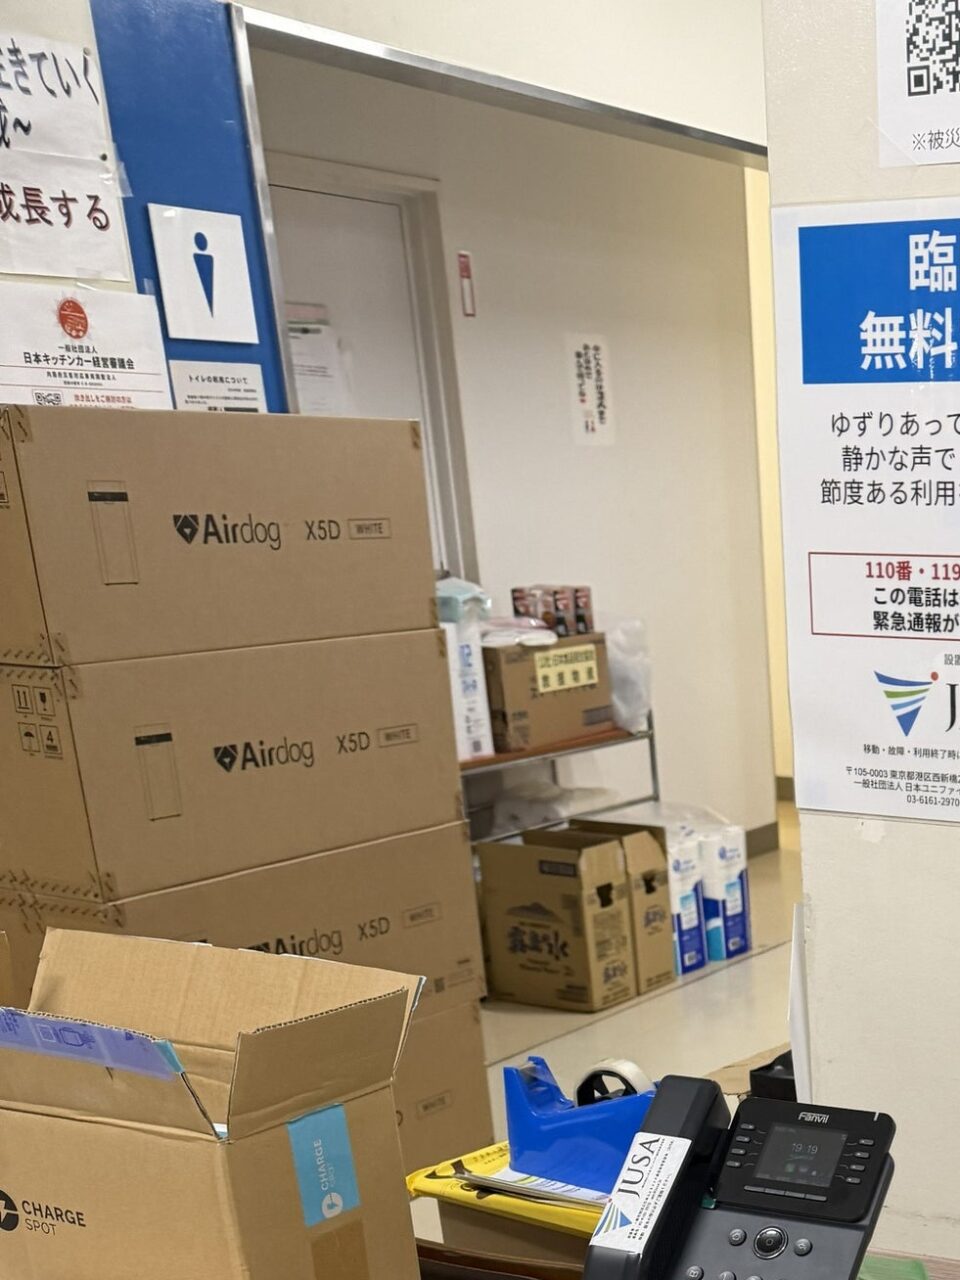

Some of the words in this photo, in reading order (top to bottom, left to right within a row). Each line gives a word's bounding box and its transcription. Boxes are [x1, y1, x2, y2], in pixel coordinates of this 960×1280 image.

[841, 445, 956, 472] 静かな声で
[202, 513, 281, 550] Airdog
[305, 518, 341, 541] X5D
[355, 522, 384, 535] WHITE
[240, 736, 314, 771] Airdog
[336, 731, 370, 754] X5D
[384, 728, 412, 741] WHITE
[906, 795, 960, 808] 03-6161-2970
[274, 927, 343, 956] Airdog
[358, 916, 390, 942] X5D
[798, 1111, 829, 1124] Fanvil
[313, 1138, 329, 1191] CHARGE
[617, 1136, 661, 1197] JUSA
[21, 1200, 87, 1227] CHARGE
[25, 1219, 57, 1236] SPOT
